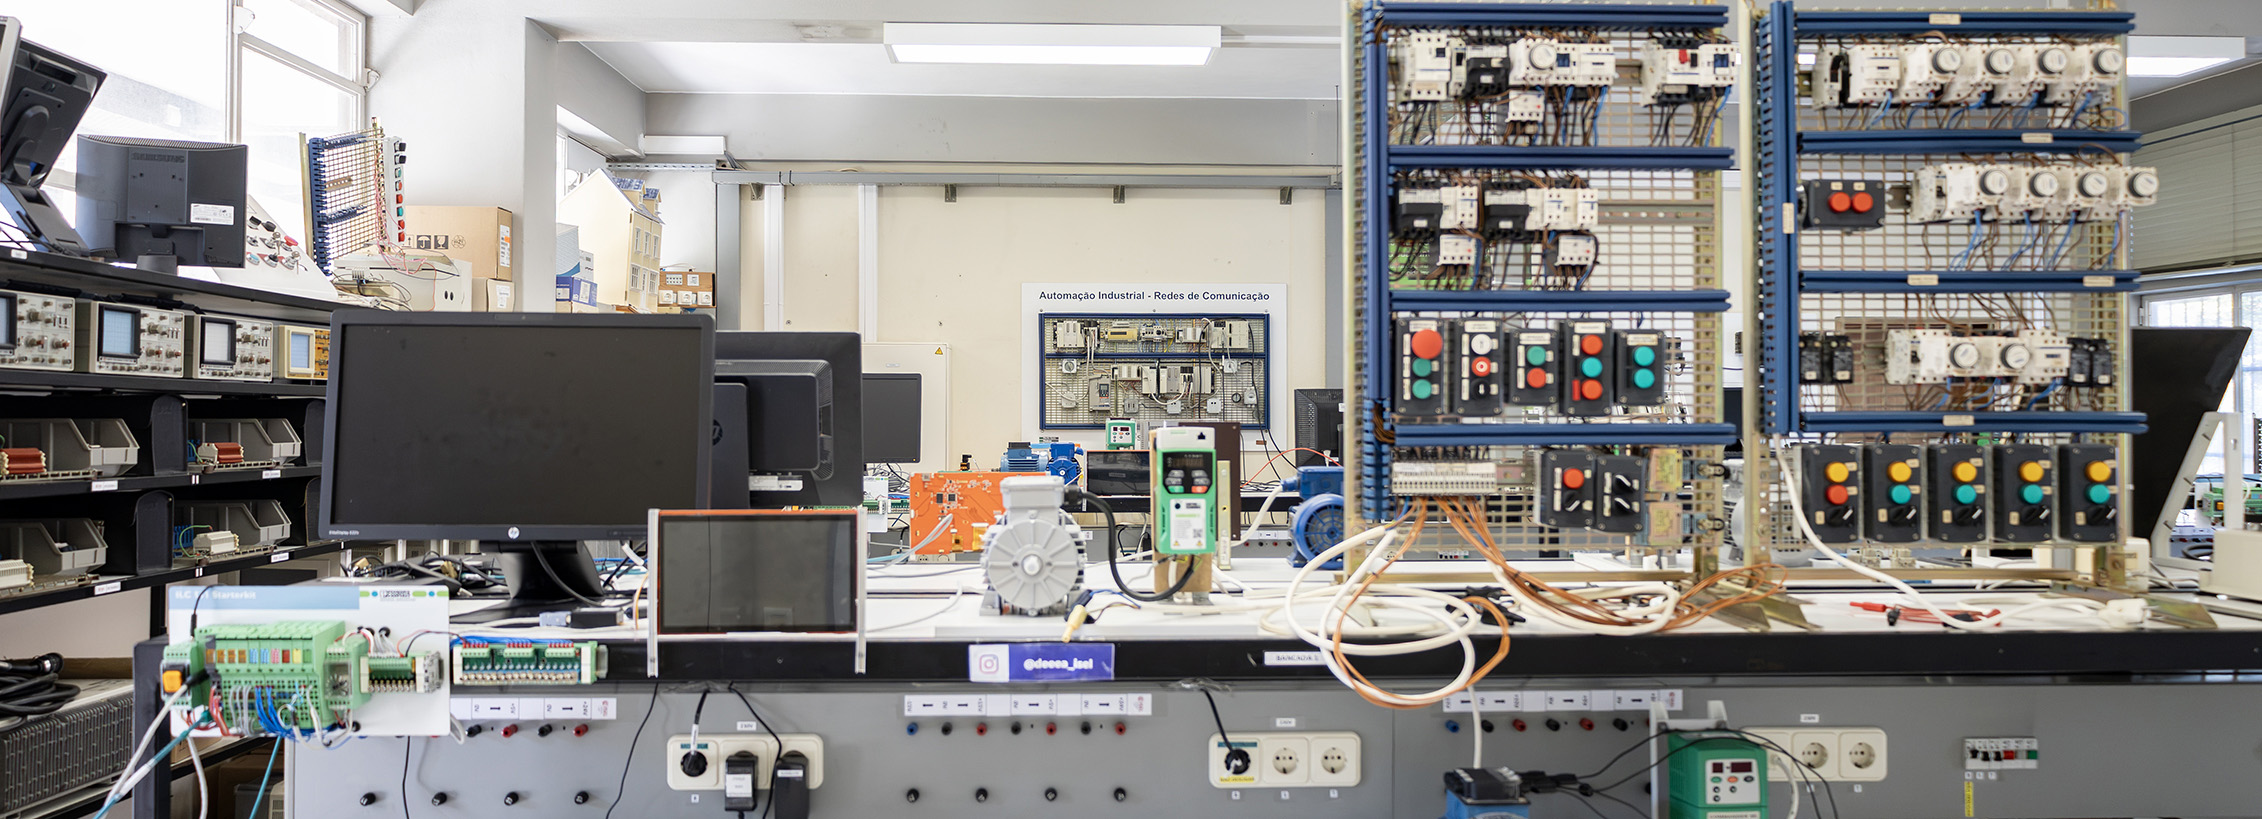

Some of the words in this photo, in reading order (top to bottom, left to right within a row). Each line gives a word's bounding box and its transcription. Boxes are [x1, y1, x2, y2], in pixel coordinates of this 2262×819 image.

[1039, 291, 1095, 302] Automação
[1098, 291, 1145, 301] Industrial
[1154, 291, 1185, 301] Redes
[1187, 291, 1200, 301] de
[1202, 291, 1270, 303] Comunicação
[212, 590, 257, 600] Starterkit
